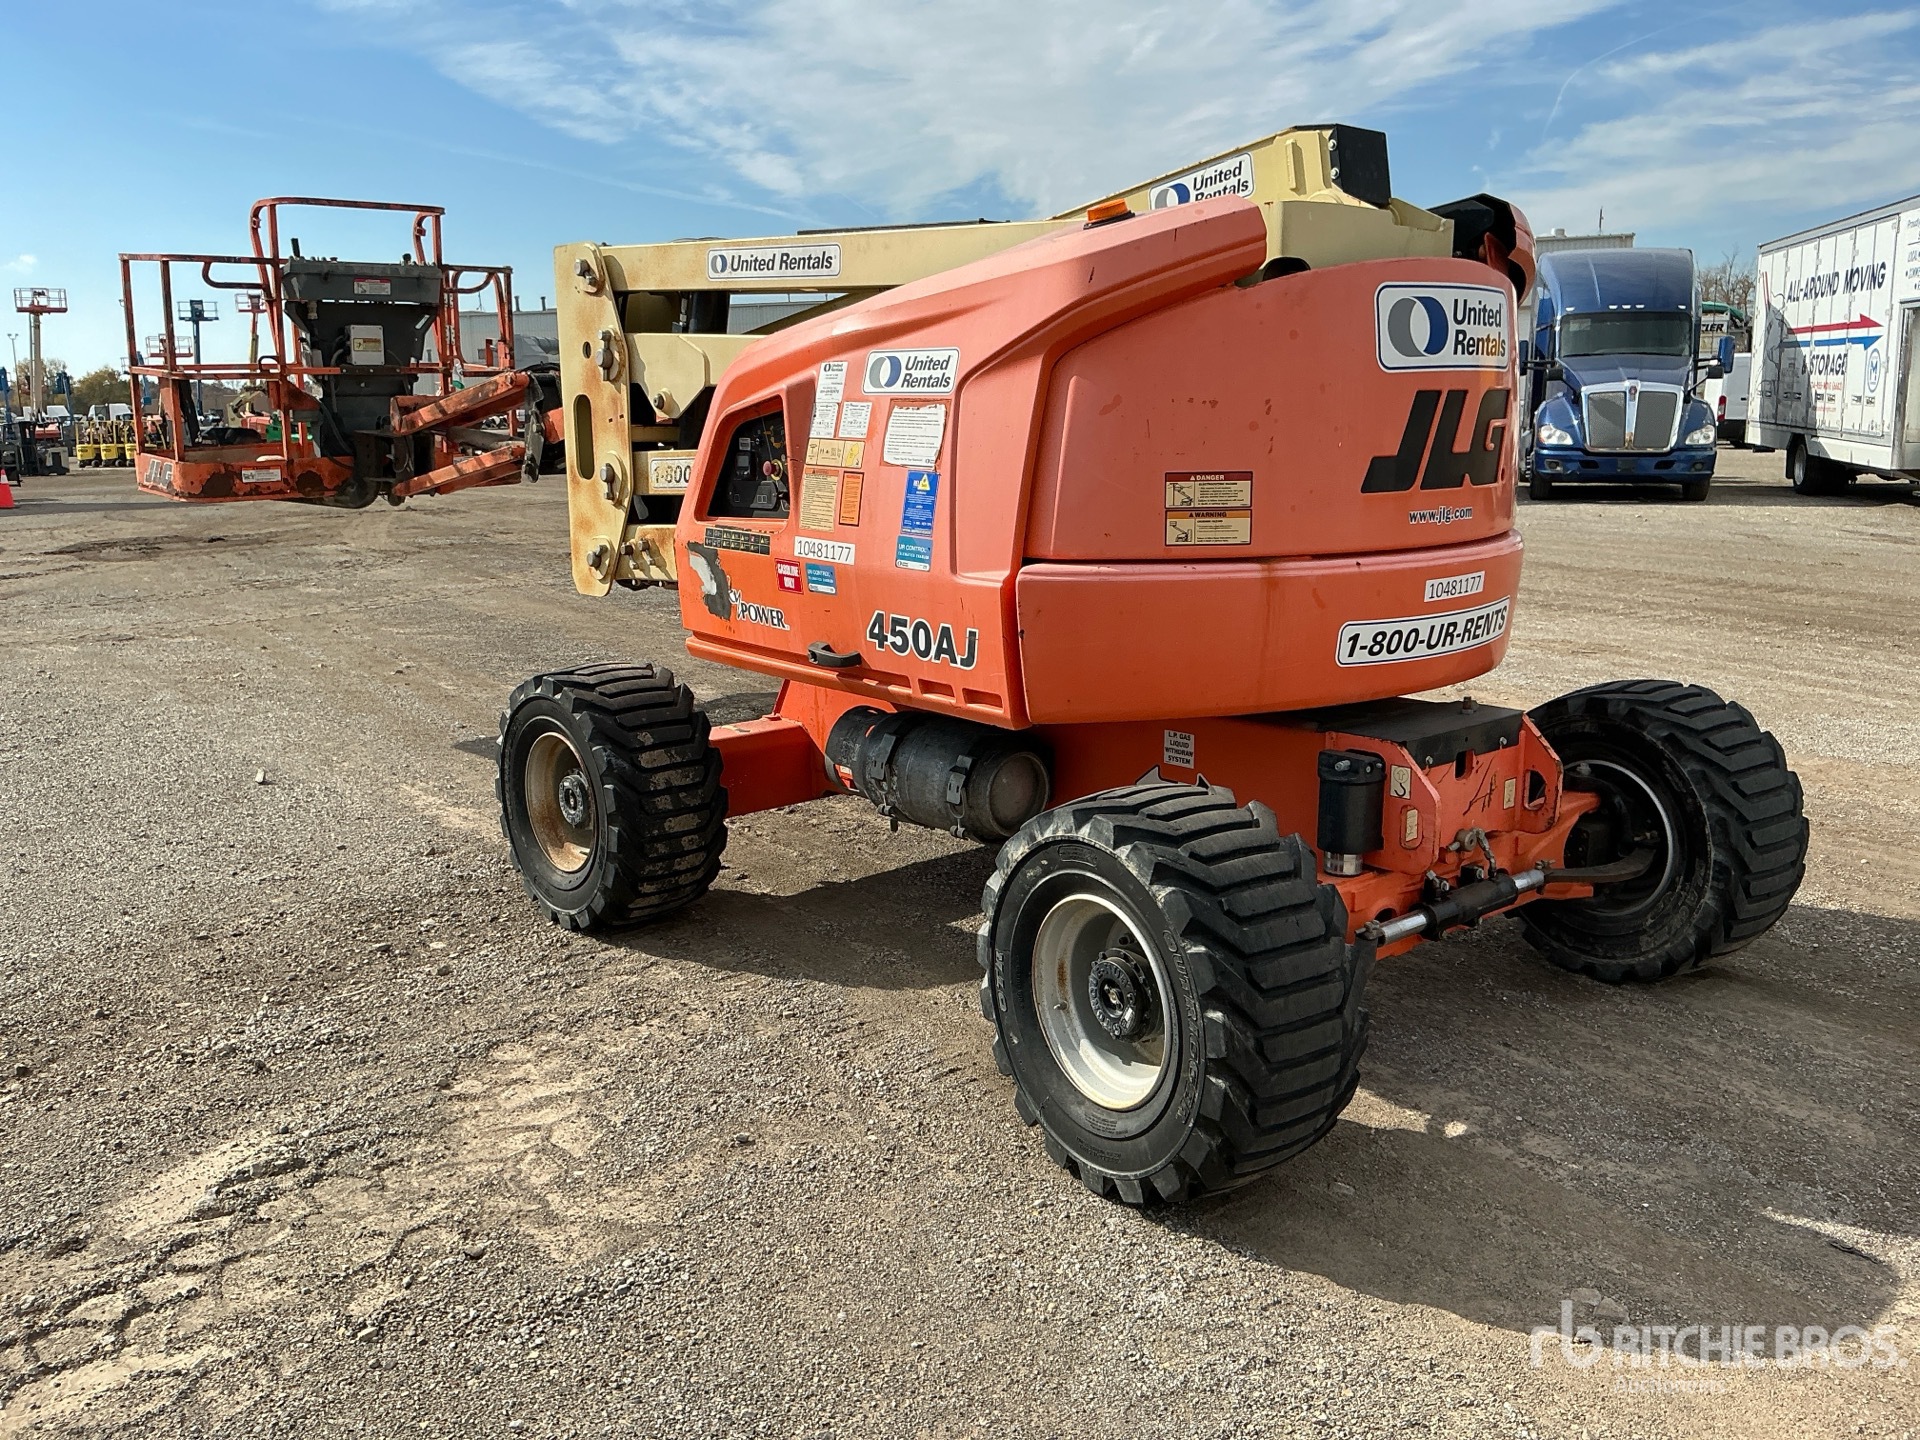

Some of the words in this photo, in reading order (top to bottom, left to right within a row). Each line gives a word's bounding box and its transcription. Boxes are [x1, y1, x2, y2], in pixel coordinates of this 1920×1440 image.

[1193, 161, 1242, 191] United
[731, 253, 776, 272] United
[779, 251, 833, 270] Rentals
[1786, 271, 1840, 303] ALL-AROUND
[1843, 261, 1887, 294] MOVING
[1453, 299, 1502, 328] United
[1453, 329, 1506, 358] Rentals
[905, 355, 951, 371] United
[1810, 353, 1848, 376] STORAGE
[901, 372, 951, 388] Rentals
[1361, 389, 1511, 494] JLG
[144, 459, 174, 489] JLG
[1409, 506, 1473, 525] www.jlg.com
[797, 540, 852, 562] 10481177
[1428, 574, 1482, 599] 10481177
[868, 611, 978, 669] 450AJ
[1346, 604, 1508, 658] 1-800-UR-RENTS
[1170, 740, 1190, 749] LIQUID
[1179, 733, 1191, 741] GAS
[1168, 755, 1191, 764] SYSTEM
